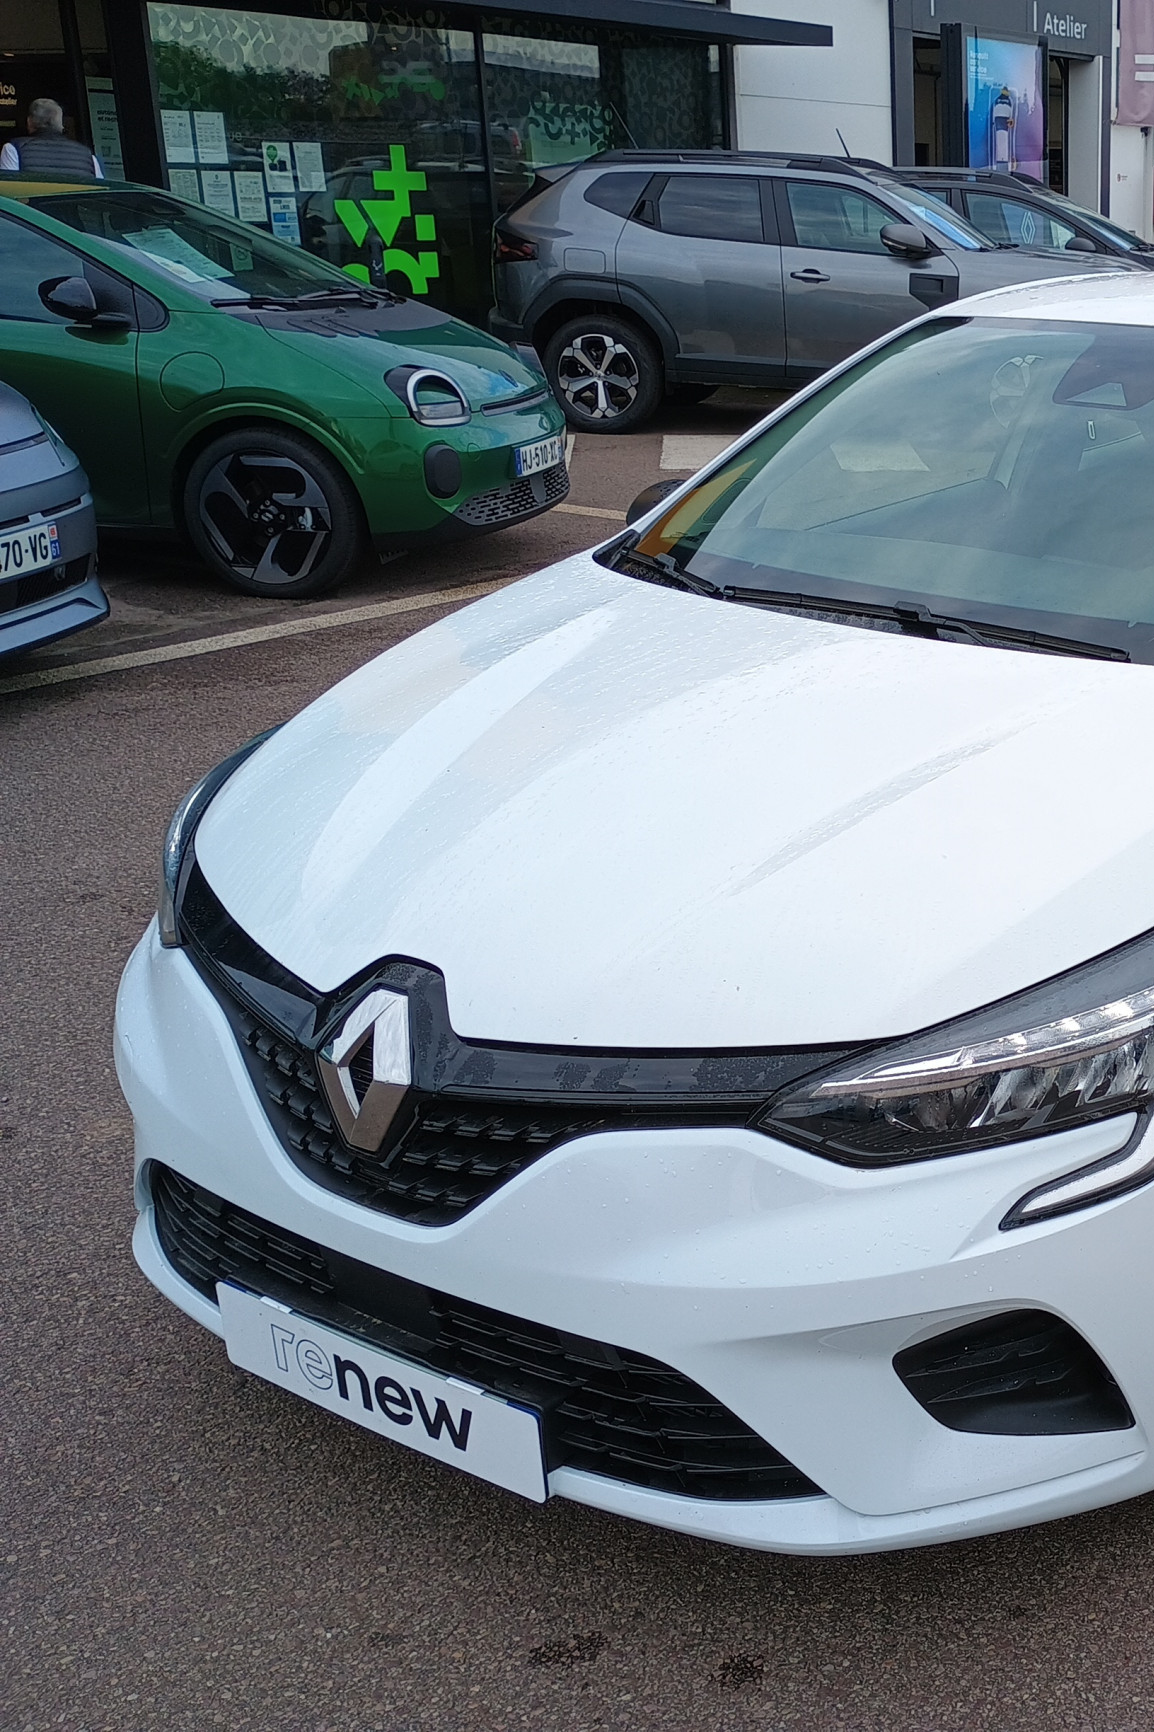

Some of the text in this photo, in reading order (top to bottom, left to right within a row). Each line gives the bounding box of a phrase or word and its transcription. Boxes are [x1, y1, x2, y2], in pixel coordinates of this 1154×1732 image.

[1043, 12, 1088, 39] Atelier
[521, 440, 558, 472] HJ-510-XC
[0, 532, 49, 573] 70-VG
[270, 1323, 473, 1452] renew
